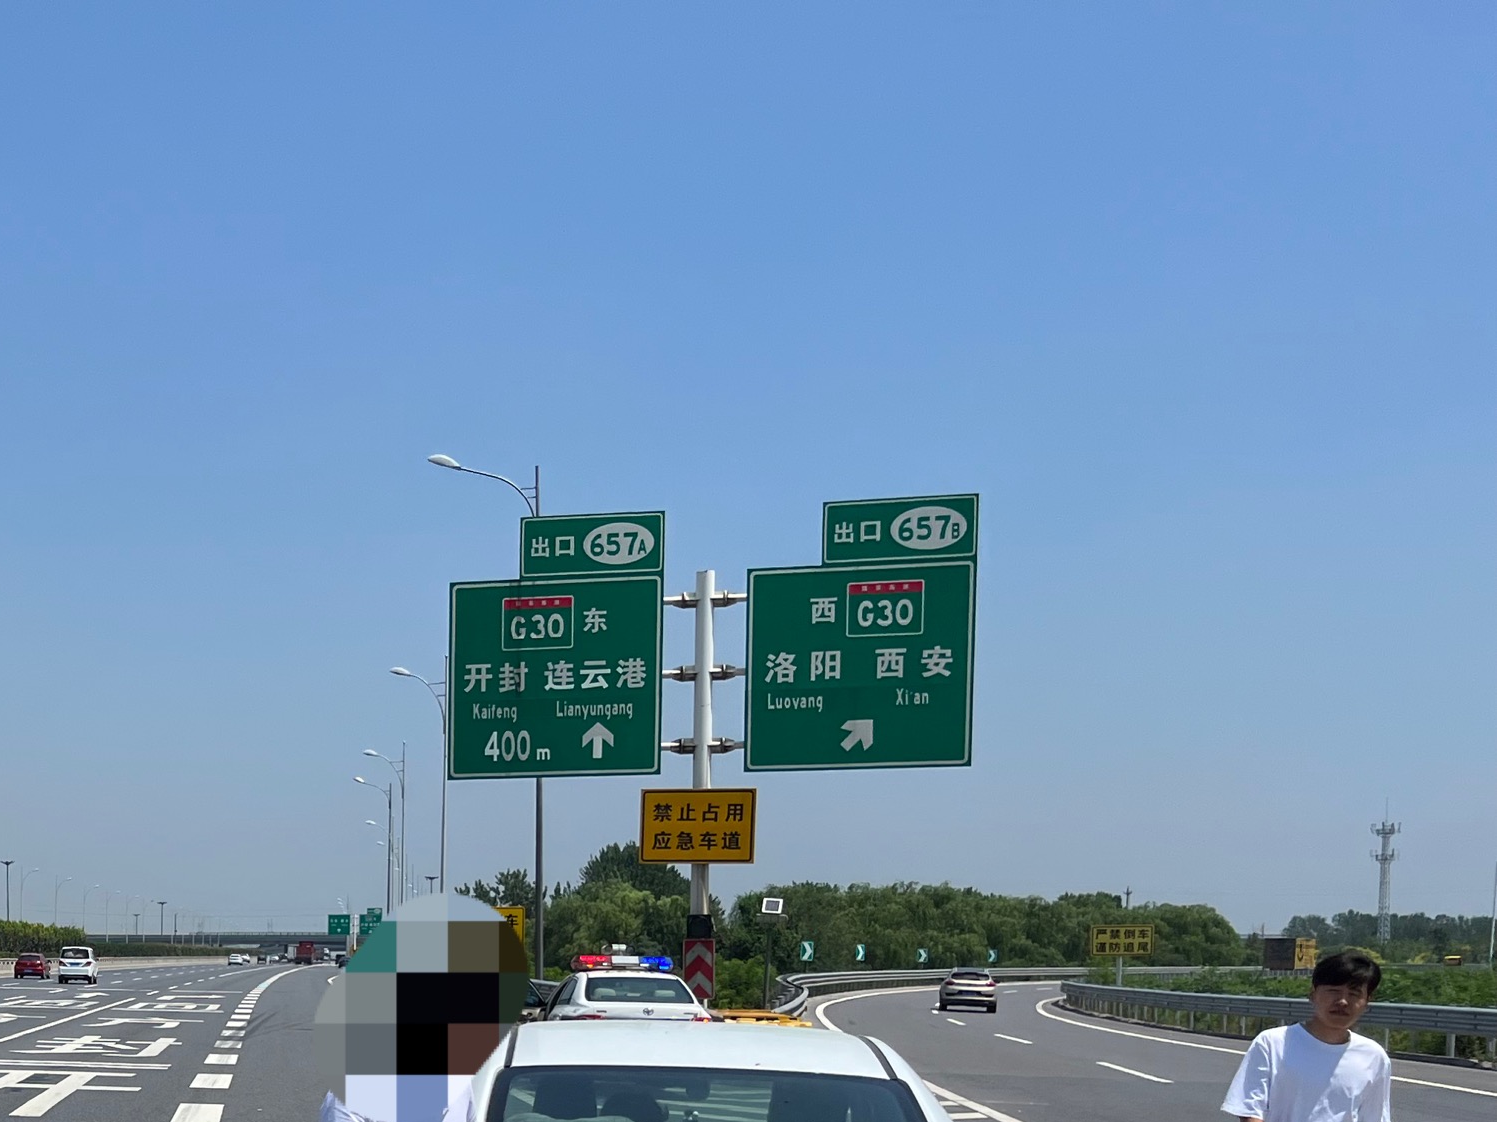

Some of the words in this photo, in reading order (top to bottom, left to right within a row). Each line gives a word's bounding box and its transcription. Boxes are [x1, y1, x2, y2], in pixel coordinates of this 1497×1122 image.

[834, 520, 881, 543] 出口
[898, 515, 960, 541] 657B
[531, 536, 575, 557] 出口
[590, 532, 647, 556] 657A
[510, 613, 565, 640] G30
[583, 607, 608, 634] 东
[810, 597, 838, 624] 西
[857, 599, 914, 627] G30
[464, 661, 529, 693] 开封
[544, 658, 647, 691] 连云港
[764, 650, 842, 684] 洛阳
[875, 645, 953, 679] 西安
[473, 703, 518, 723] Kaifeng
[556, 700, 634, 720] Lianyungang
[484, 730, 531, 762] 400
[536, 747, 551, 761] m
[652, 803, 744, 823] 禁止占用
[651, 831, 741, 851] 应急车道
